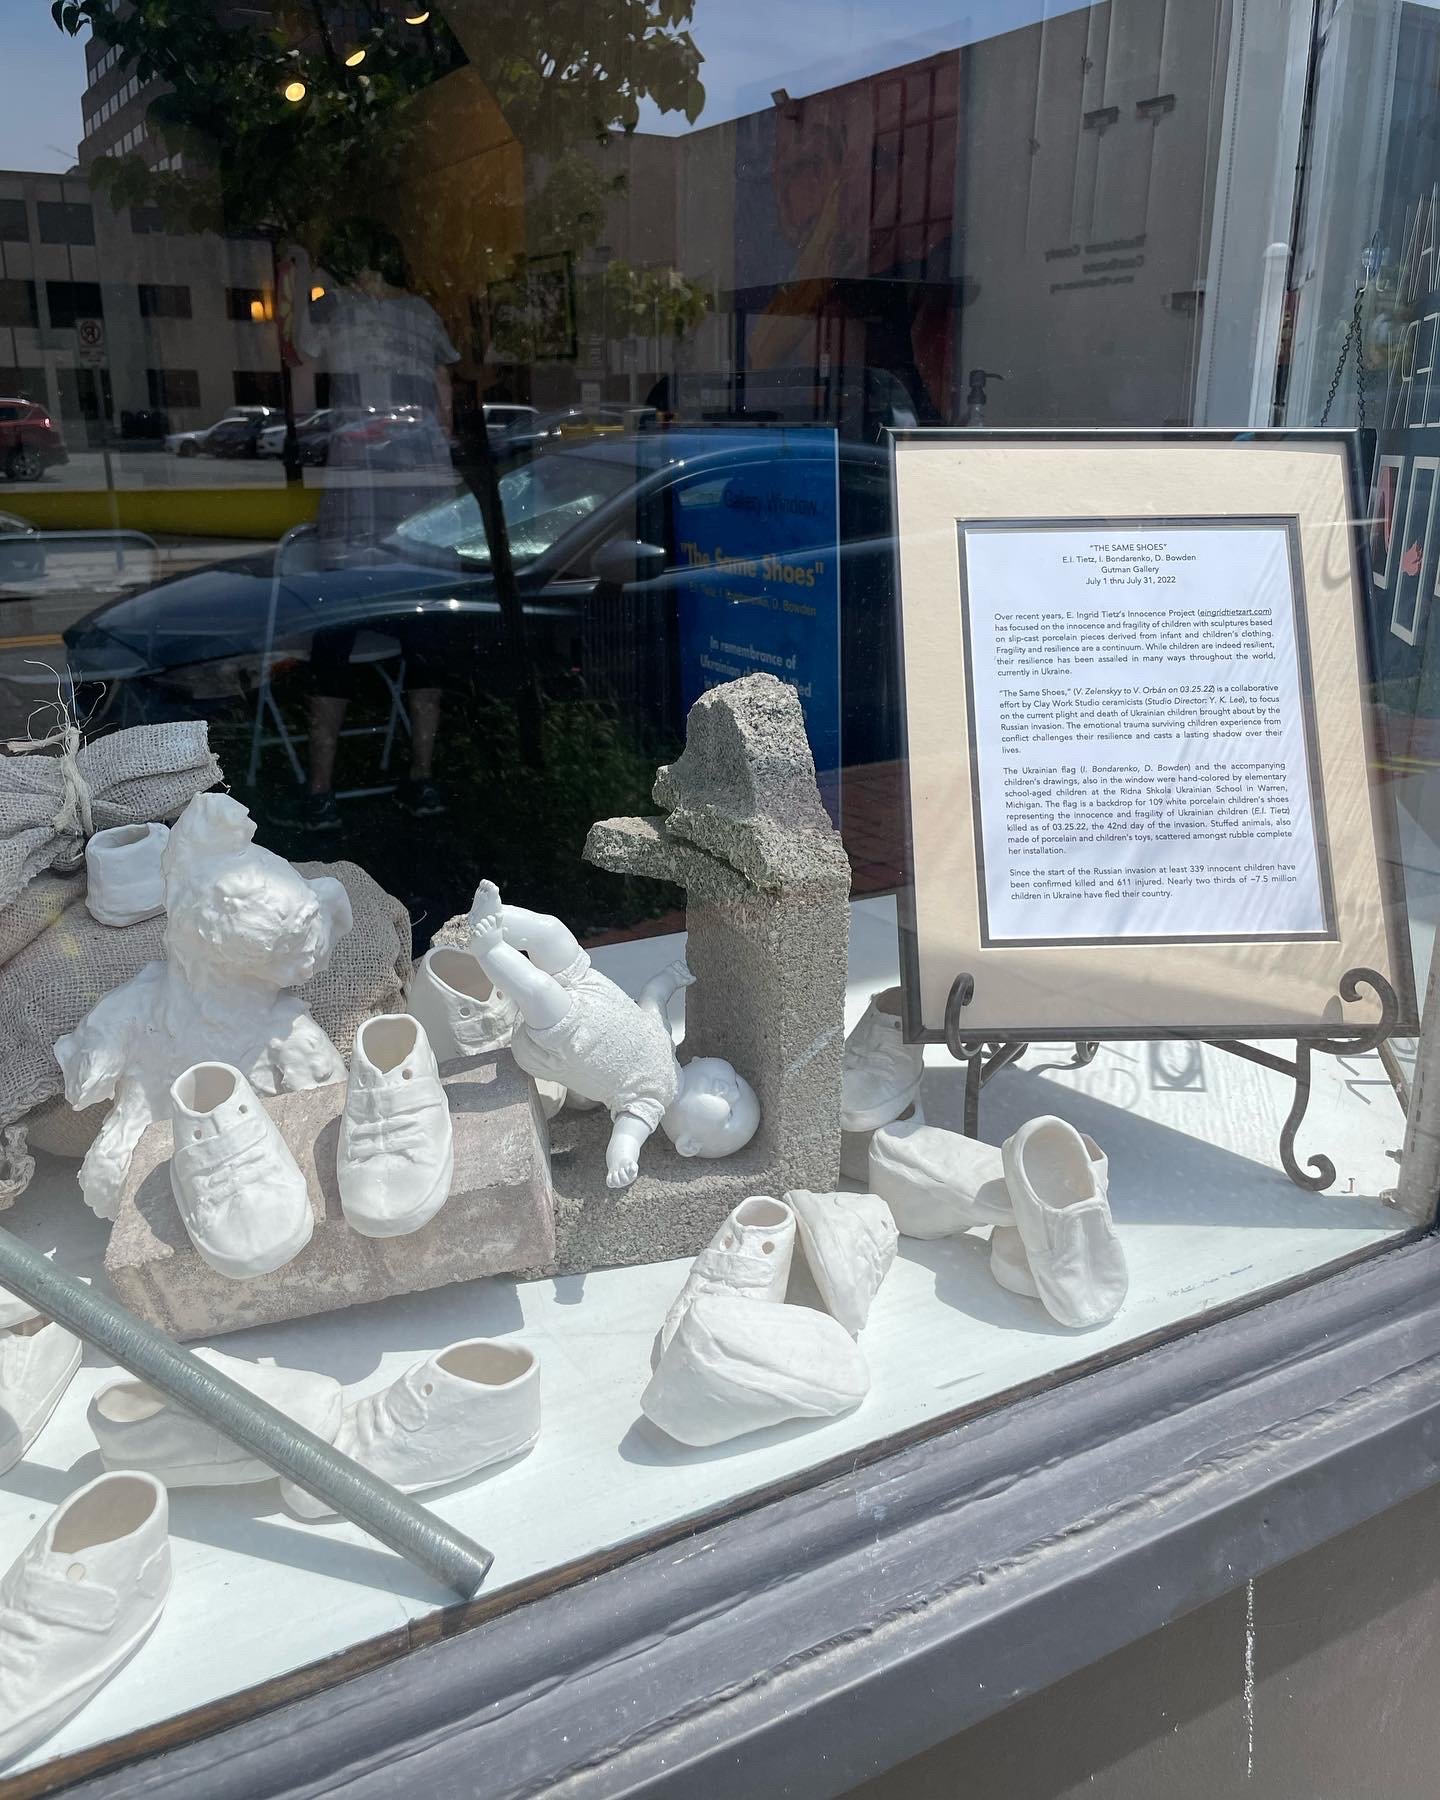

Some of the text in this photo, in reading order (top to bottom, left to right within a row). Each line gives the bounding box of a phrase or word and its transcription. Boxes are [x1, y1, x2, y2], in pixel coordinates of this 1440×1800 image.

[1112, 544, 1135, 552] SAME
[680, 541, 709, 566] "The
[762, 554, 824, 587] Shoes"
[1076, 556, 1097, 564] Tietz,
[1105, 554, 1153, 563] Bondarenko,
[1165, 553, 1196, 562] Bowden
[1101, 565, 1160, 575] Gutman Gallery
[1086, 577, 1101, 587] July
[1110, 577, 1125, 585] thru
[1126, 576, 1142, 586] July
[1143, 576, 1155, 585] 31,
[1157, 576, 1176, 584] 2022
[995, 613, 1014, 621] Over
[1041, 614, 1065, 622] years,
[1076, 611, 1099, 621] Ingrid
[1101, 610, 1126, 618] Tietz's
[1127, 610, 1166, 618] Innocence
[1168, 609, 1196, 619] Project
[995, 624, 1008, 632] has
[1009, 623, 1039, 631] focused
[1066, 622, 1106, 630] innocence
[1106, 621, 1122, 629] and
[1122, 621, 1151, 631] fragility
[1161, 620, 1192, 628] children
[1210, 619, 1249, 630] sculptures
[1250, 618, 1273, 626] based
[996, 646, 1026, 656] Fragility
[1044, 645, 1080, 653] resilience
[1101, 644, 1144, 652] continuum.
[1145, 643, 1167, 651] While
[1243, 641, 1275, 651] resilient,
[720, 643, 783, 666] remembrance
[785, 654, 796, 670] of
[998, 668, 1031, 678] currently
[1041, 667, 1072, 676] Ukraine.
[1012, 712, 1025, 720] the
[1026, 711, 1054, 719] current
[1055, 710, 1078, 720] plight
[1079, 710, 1095, 719] and
[1096, 710, 1119, 718] death
[1120, 709, 1129, 717] of
[1130, 709, 1165, 718] Ukrainian
[1167, 708, 1198, 716] children
[1199, 708, 1231, 718] brought
[1232, 707, 1255, 715] about
[1256, 707, 1267, 716] by
[1001, 723, 1029, 731] Russian
[1031, 722, 1065, 730] invasion.
[1066, 722, 1081, 730] The
[1083, 721, 1122, 729] emotional
[1151, 720, 1185, 730] surviving
[1187, 719, 1218, 727] children
[1219, 718, 1262, 728] experience
[1002, 734, 1029, 743] conflict
[1032, 733, 1075, 743] challenges
[1076, 733, 1094, 741] their
[1097, 732, 1133, 740] resilience
[1135, 732, 1151, 740] and
[1184, 730, 1209, 741] lasting
[1212, 730, 1242, 738] shadow
[1265, 729, 1283, 737] their
[1002, 746, 1021, 754] lives.
[1004, 778, 1041, 786] children's
[1042, 777, 1080, 787] drawings,
[1110, 776, 1123, 784] the
[1125, 776, 1155, 784] window
[1178, 774, 1230, 783] hand-colored
[1232, 774, 1243, 783] by
[1244, 773, 1287, 784] elementary
[1006, 800, 1043, 811] Michigan.
[1045, 800, 1060, 808] The
[1062, 799, 1078, 810] flag
[1096, 798, 1133, 810] backdrop
[1135, 798, 1147, 806] for
[1149, 798, 1164, 807] 109
[1164, 797, 1187, 806] white
[1189, 797, 1225, 808] porcelain
[1227, 796, 1265, 804] children's
[1008, 830, 1293, 845] made of porcelain and children's toys, scattered amongst rubble complete
[1009, 846, 1066, 855] her installation.
[1010, 868, 1030, 877] Since
[1032, 868, 1046, 876] the
[1067, 867, 1076, 876] of
[1078, 867, 1093, 876] the
[1093, 867, 1123, 875] Russian
[1125, 866, 1157, 875] invasion
[1169, 865, 1188, 873] least
[1190, 865, 1206, 873] 339
[1206, 864, 1242, 873] innocent
[1243, 864, 1275, 872] children
[1277, 863, 1296, 871] have
[1011, 892, 1042, 900] children
[1052, 891, 1082, 900] Ukraine
[1084, 890, 1103, 899] have
[1104, 890, 1120, 898] fled
[1121, 890, 1140, 898] their
[1141, 889, 1173, 899] country.
